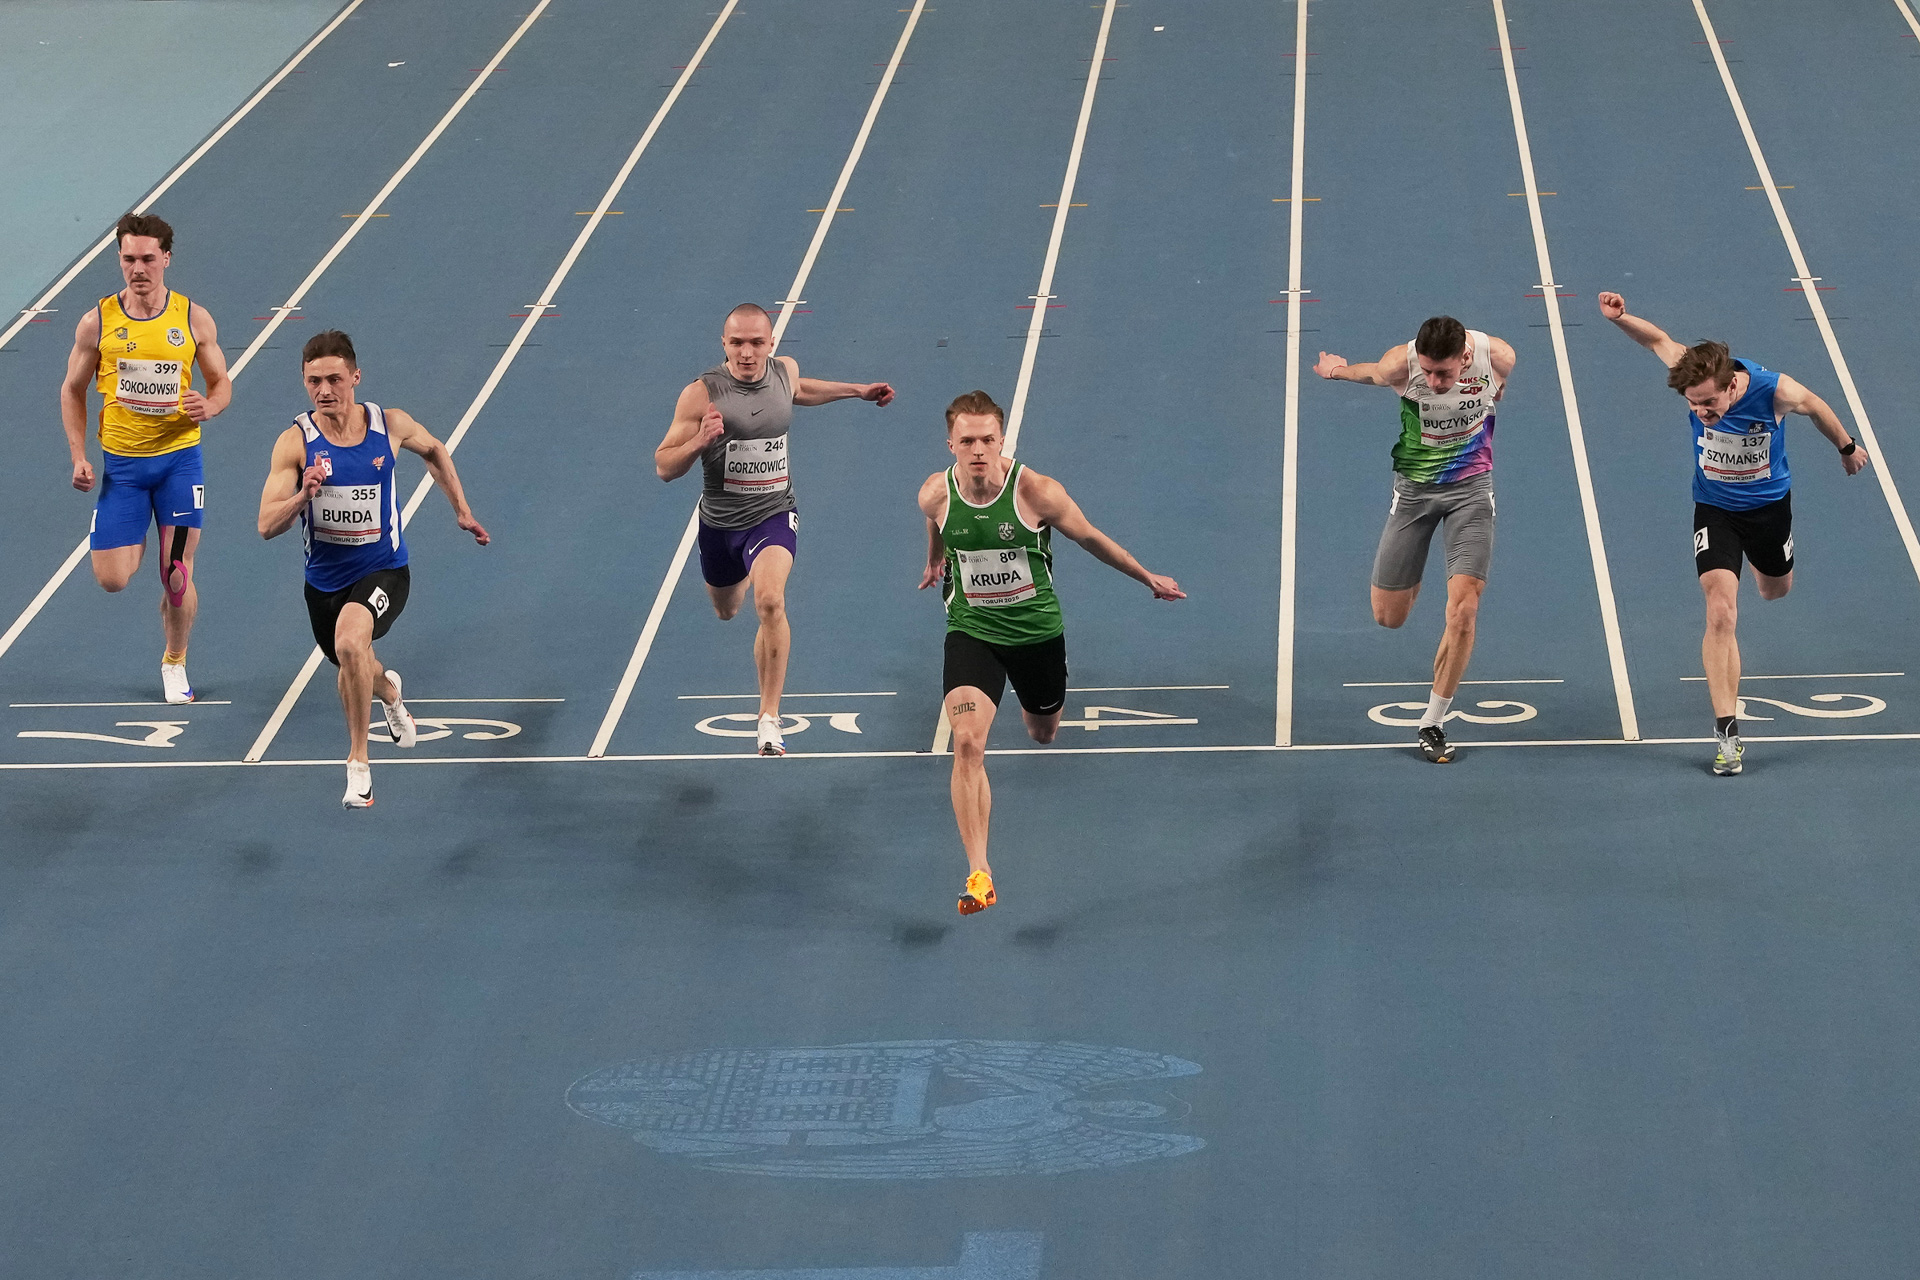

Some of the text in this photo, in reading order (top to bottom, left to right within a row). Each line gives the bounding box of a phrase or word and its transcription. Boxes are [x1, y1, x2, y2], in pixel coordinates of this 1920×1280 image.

[154, 363, 178, 375] 399
[120, 379, 179, 395] SOKOŁOWSKI
[1459, 376, 1478, 384] MKS
[1458, 398, 1483, 411] 201
[1423, 409, 1484, 430] BUCZYŃSKI
[764, 438, 784, 453] 246
[1741, 436, 1766, 448] 137
[728, 457, 786, 473] GORZKOWICZ
[1707, 449, 1768, 465] SZYMAŃSKI
[196, 487, 203, 507] 7
[351, 488, 376, 501] 355
[322, 508, 373, 524] BURDA
[1695, 532, 1704, 552] 2
[999, 551, 1017, 564] 80
[971, 570, 1022, 586] KRUPA
[375, 593, 388, 611] 6
[1367, 700, 1538, 727] 3
[1736, 692, 1887, 722] 2
[694, 711, 862, 738] 5
[1058, 705, 1199, 731] 4
[17, 720, 190, 748] 7
[367, 717, 522, 743] 6
